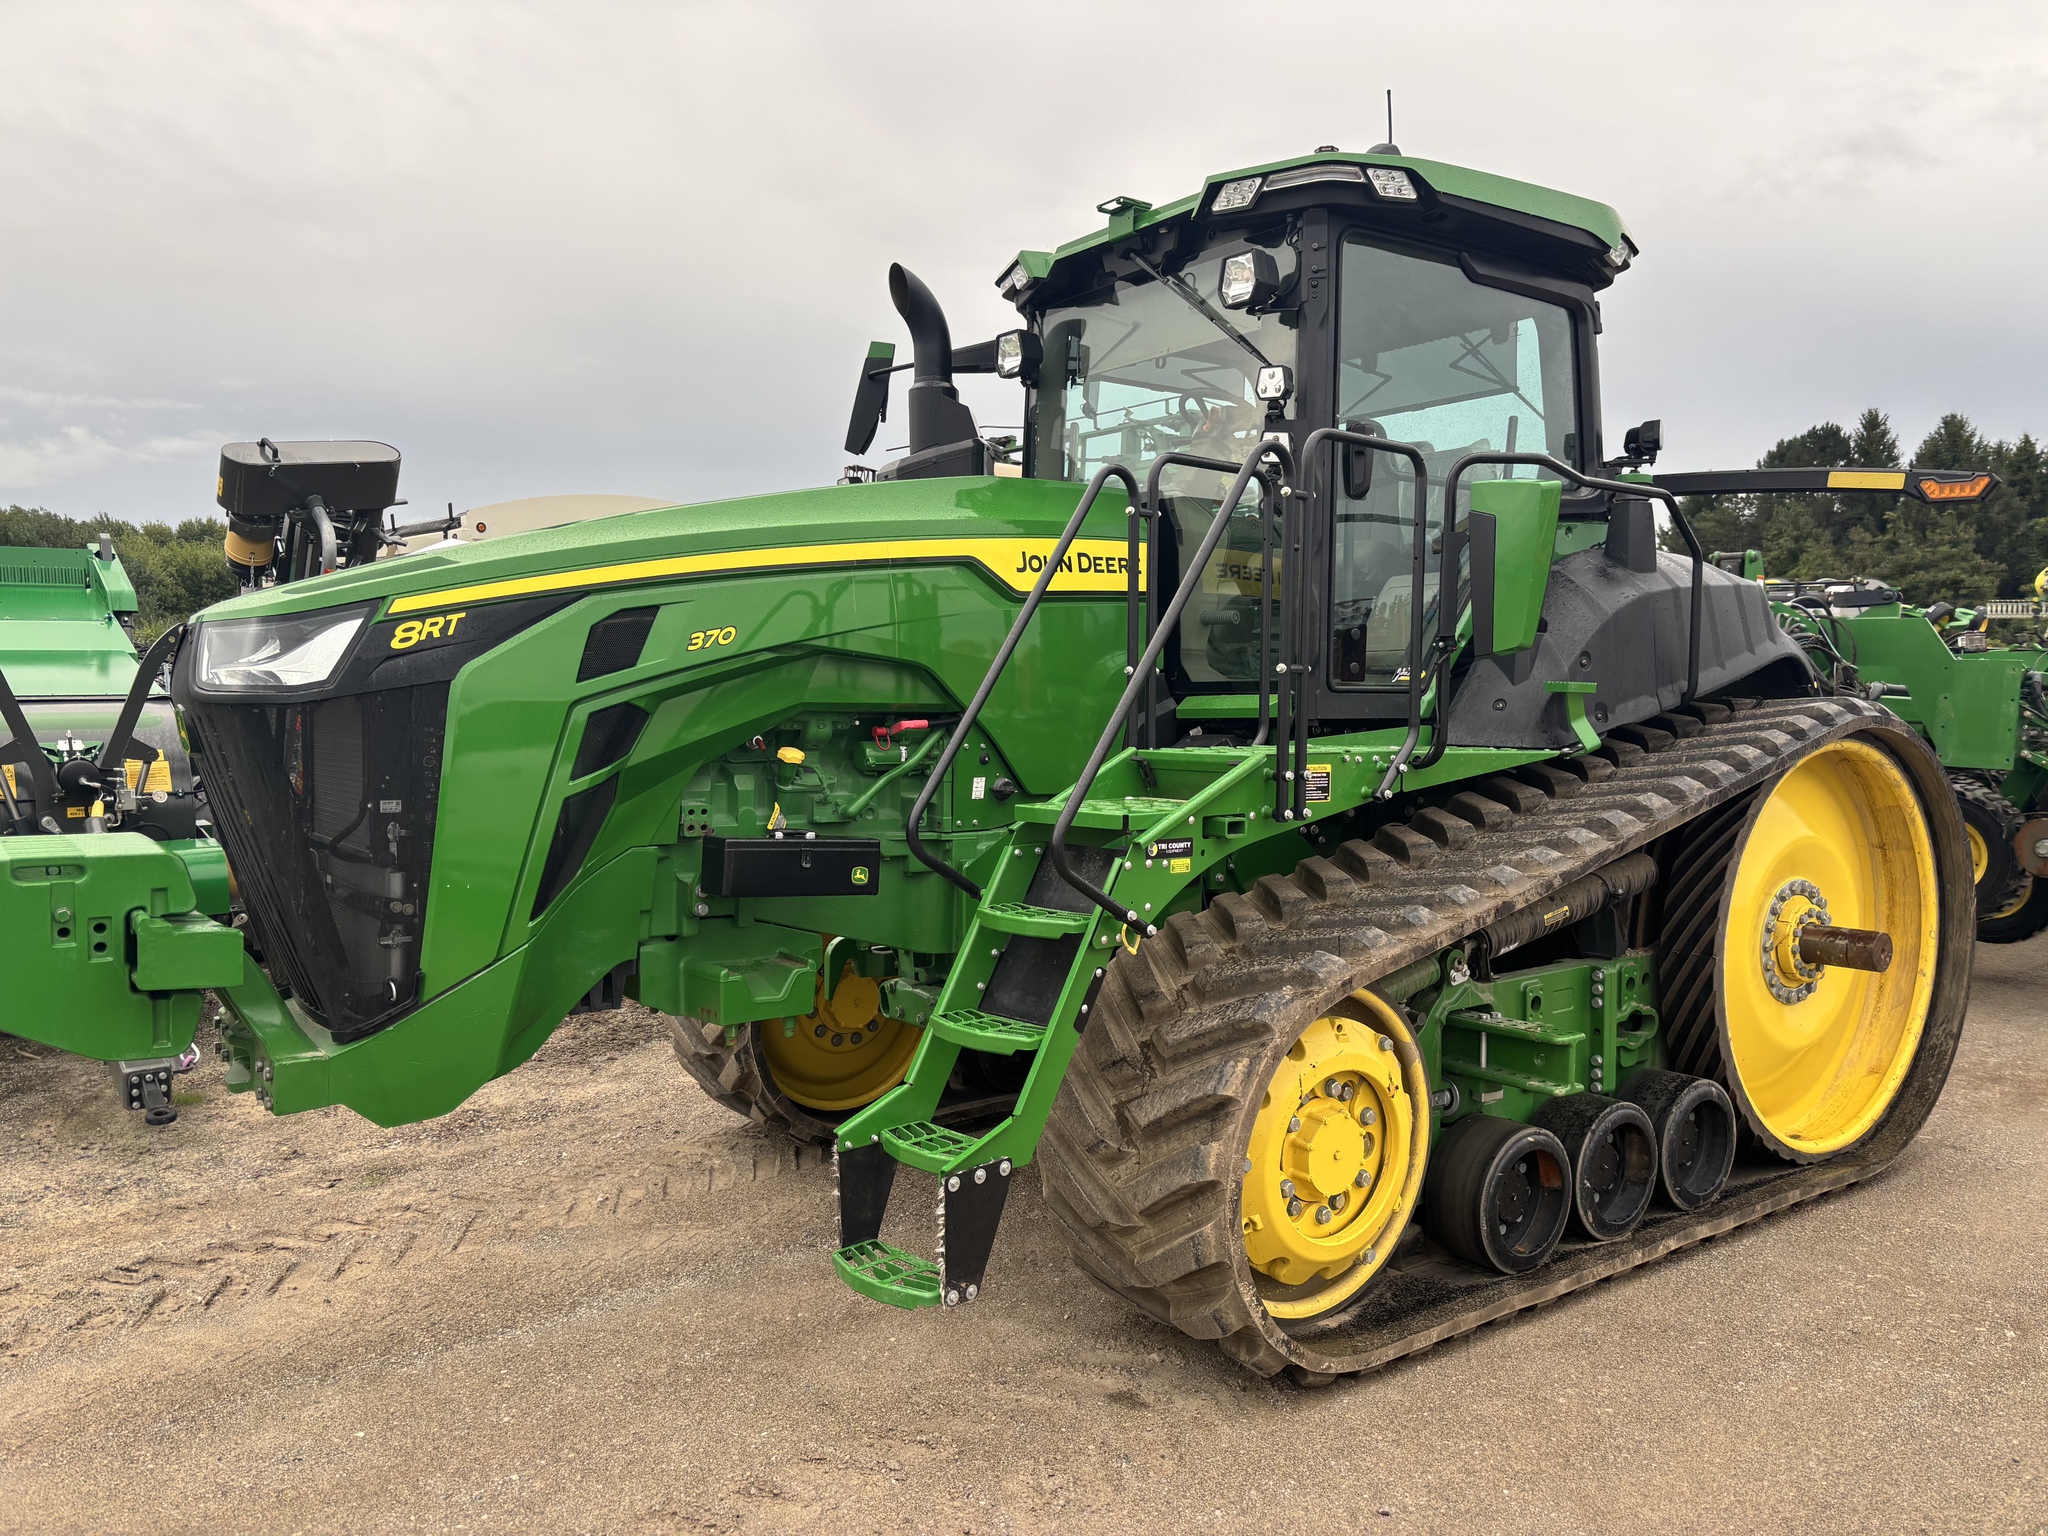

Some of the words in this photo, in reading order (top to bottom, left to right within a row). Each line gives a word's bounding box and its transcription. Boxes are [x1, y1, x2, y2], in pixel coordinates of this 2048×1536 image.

[1077, 552, 1142, 575] DEER
[390, 612, 466, 650] 8RT
[686, 626, 737, 651] 370
